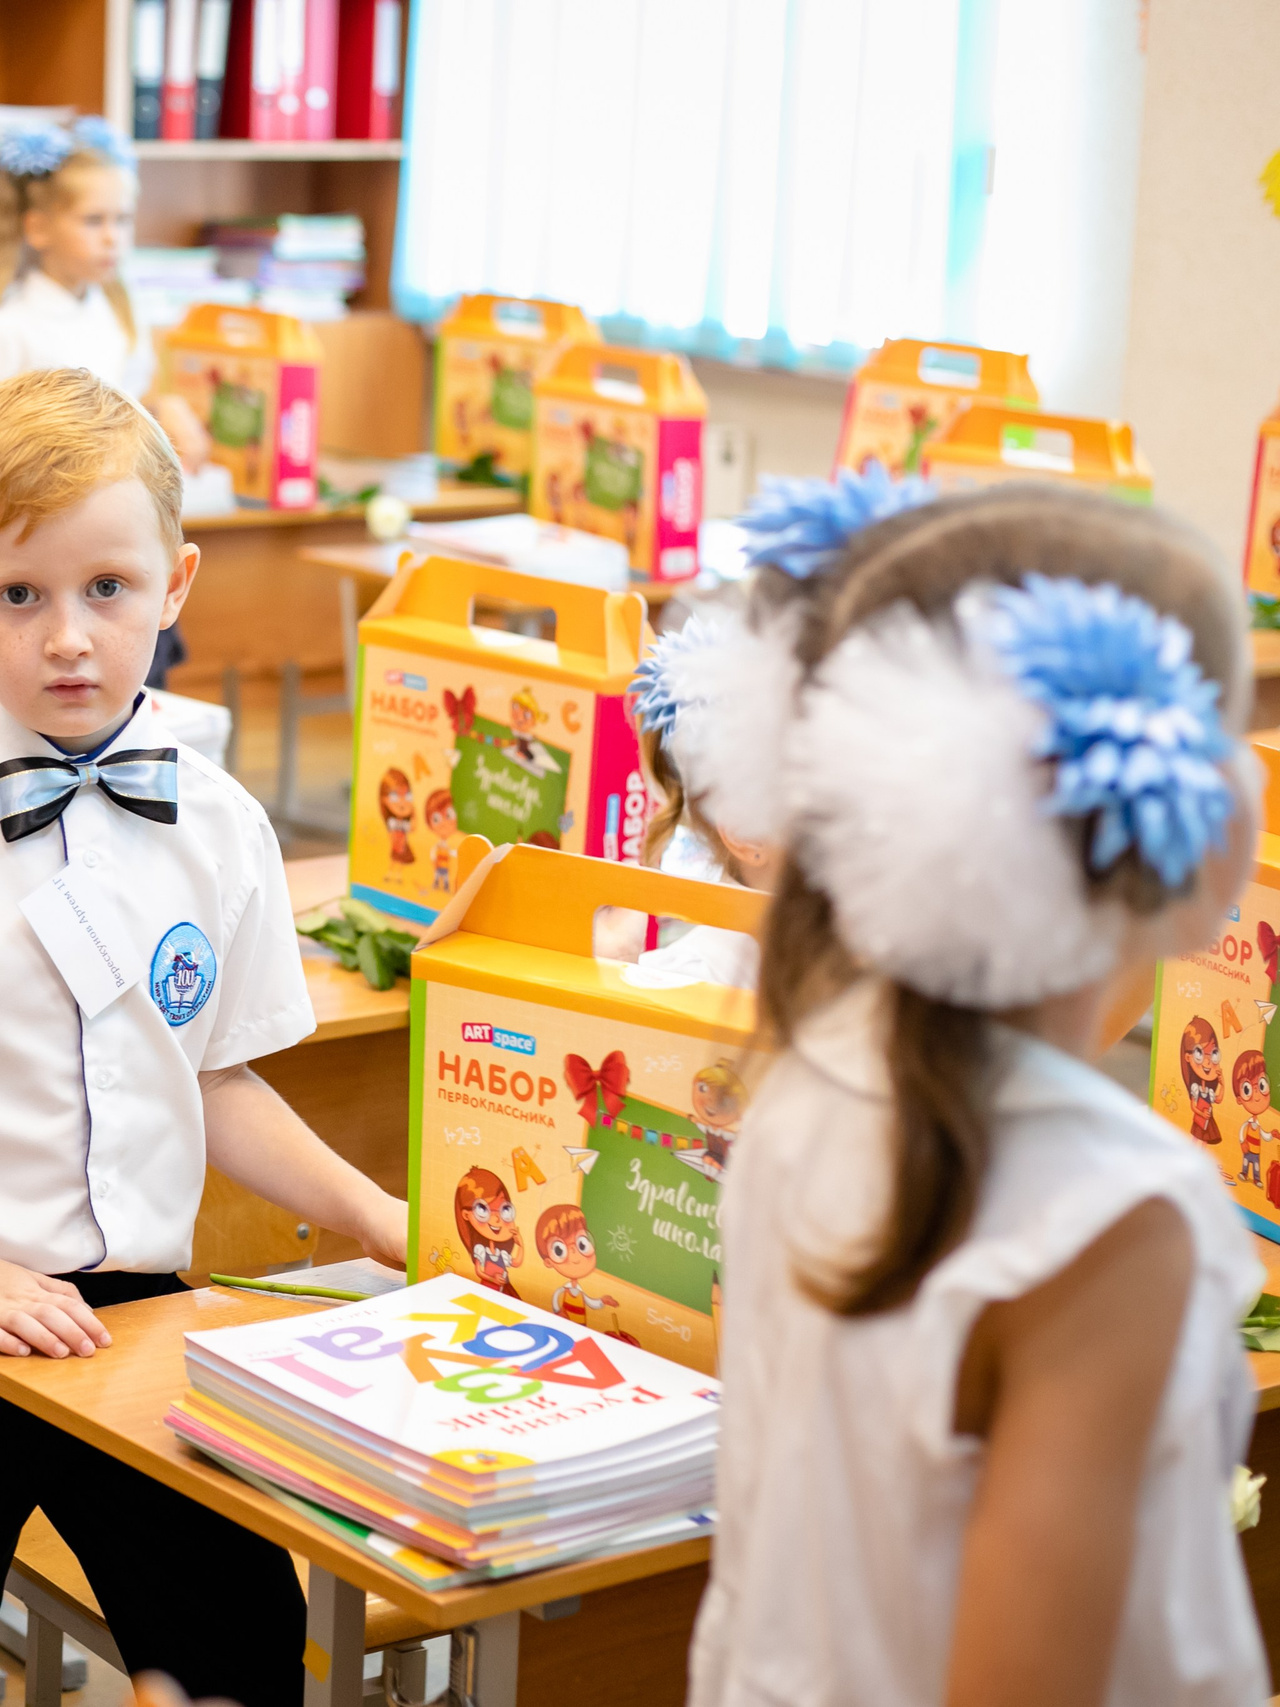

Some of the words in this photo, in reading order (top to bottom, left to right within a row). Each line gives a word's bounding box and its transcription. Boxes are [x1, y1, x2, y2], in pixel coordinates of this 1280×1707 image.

[371, 690, 439, 724] НАБОР
[52, 878, 66, 891] 1Г
[64, 890, 89, 924] Артем
[85, 925, 125, 988] Верескунов
[464, 1024, 492, 1041] ART
[494, 1031, 534, 1051] space
[438, 1050, 558, 1108] НАБОР
[437, 1088, 556, 1129] ПЕРВОКЛАССНИКА
[498, 1384, 670, 1438] Русский
